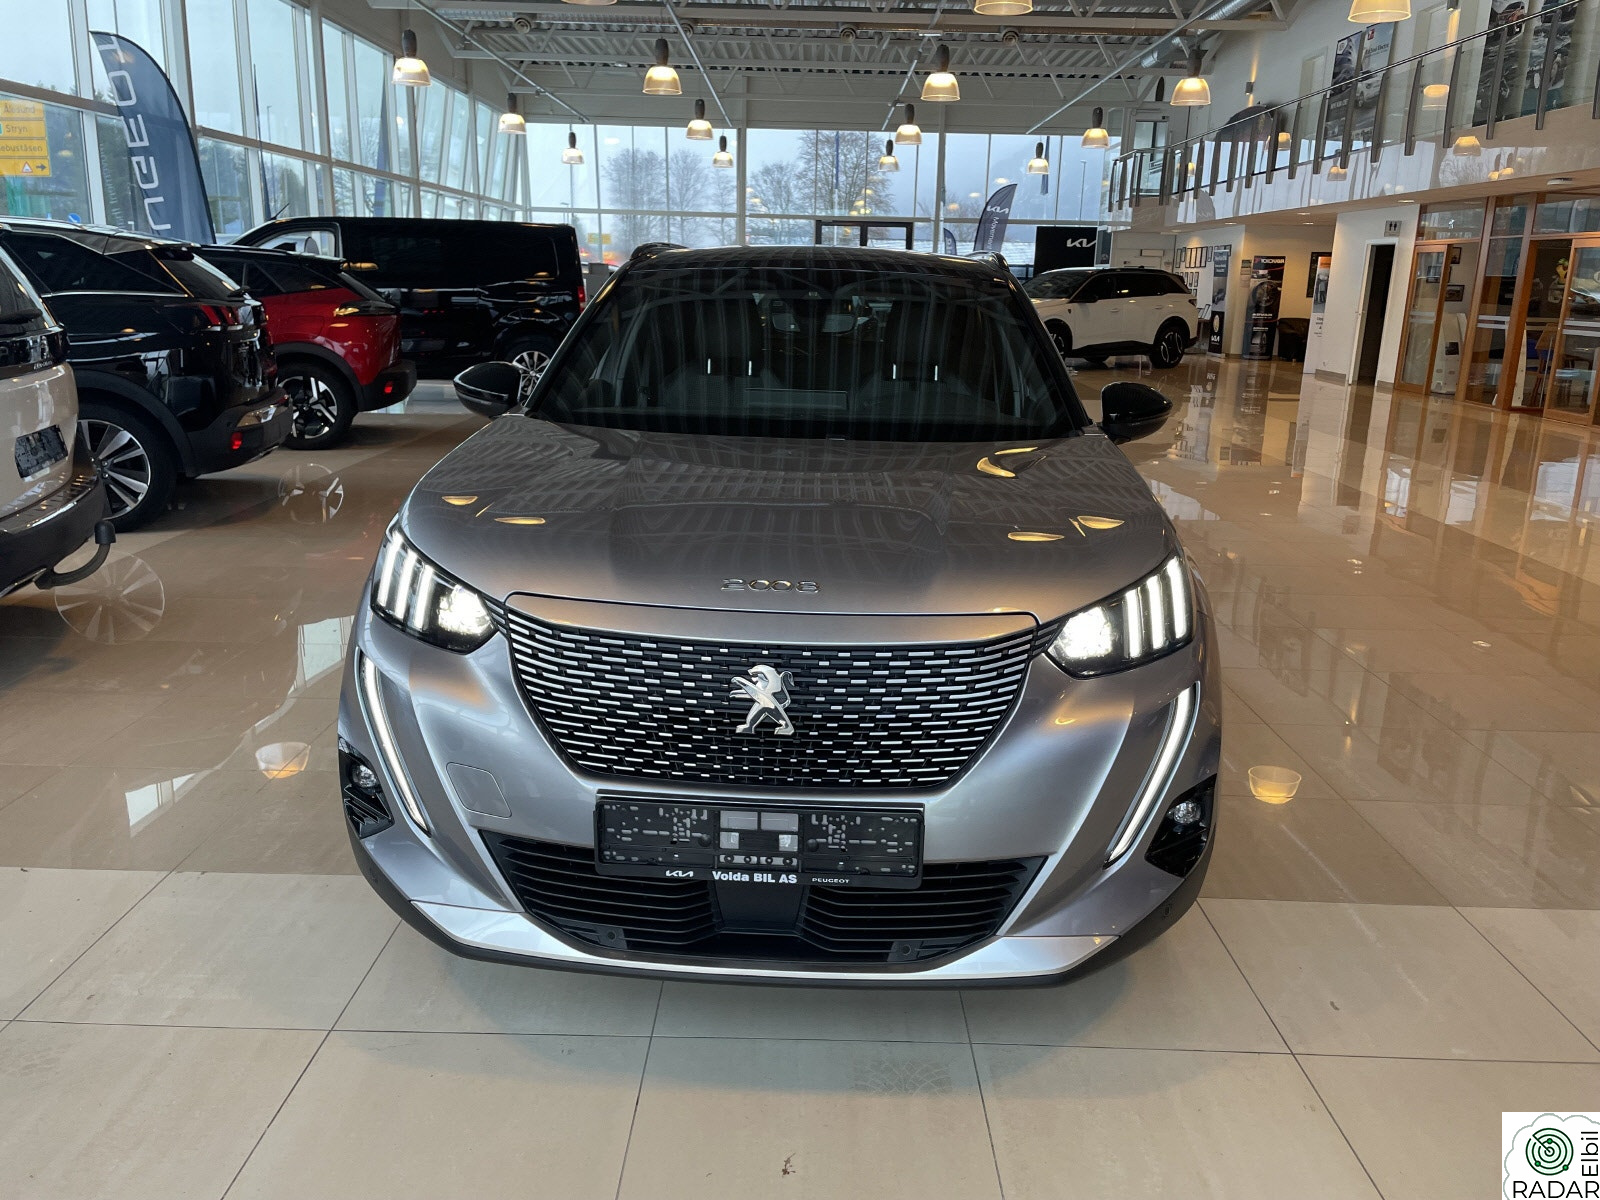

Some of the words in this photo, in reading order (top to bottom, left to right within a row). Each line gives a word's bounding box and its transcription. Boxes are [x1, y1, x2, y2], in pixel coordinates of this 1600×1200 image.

[5, 125, 28, 134] Stryn
[0, 144, 43, 152] ebuståsen
[721, 578, 820, 593] 2008
[712, 870, 750, 882] Volda
[753, 873, 776, 883] BIL
[779, 874, 798, 884] AS
